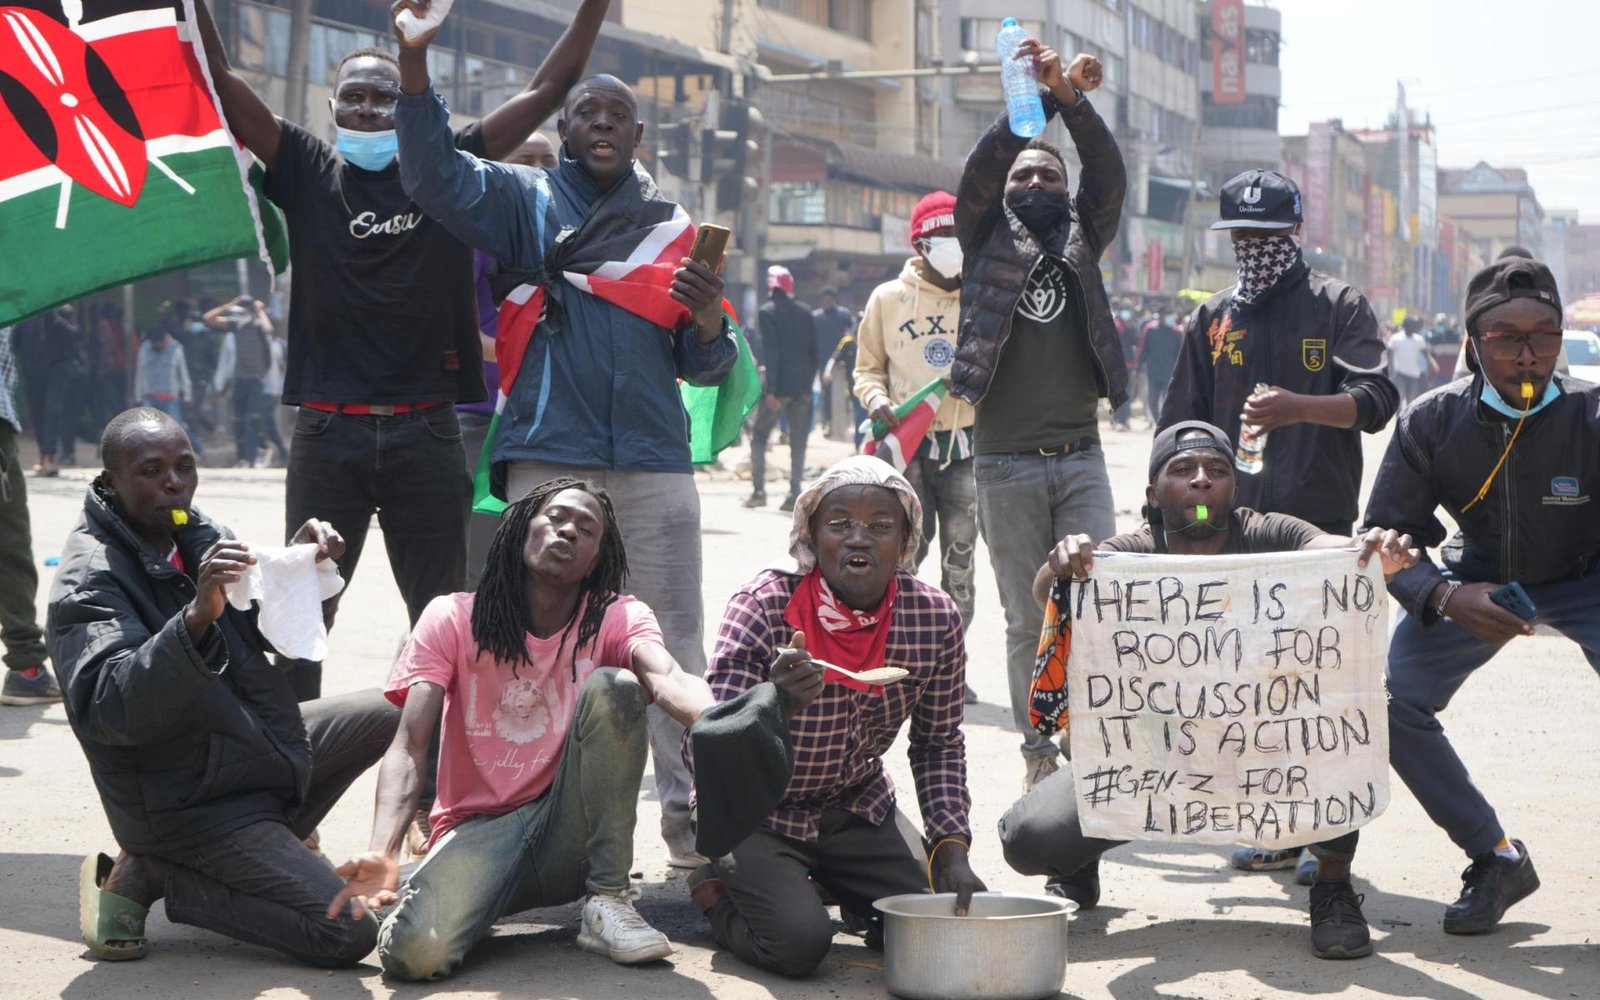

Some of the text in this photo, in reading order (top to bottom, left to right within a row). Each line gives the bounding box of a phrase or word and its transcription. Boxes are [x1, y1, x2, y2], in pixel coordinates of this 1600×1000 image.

[1071, 574, 1375, 626] THERE IS NO
[1112, 626, 1342, 671] ROOM FOR
[1087, 674, 1322, 720] DISCUSSION
[1099, 709, 1371, 758] IT IS ACTION
[1083, 765, 1309, 809] #GEN-Z FOR
[1142, 781, 1376, 840] LIBERATION
